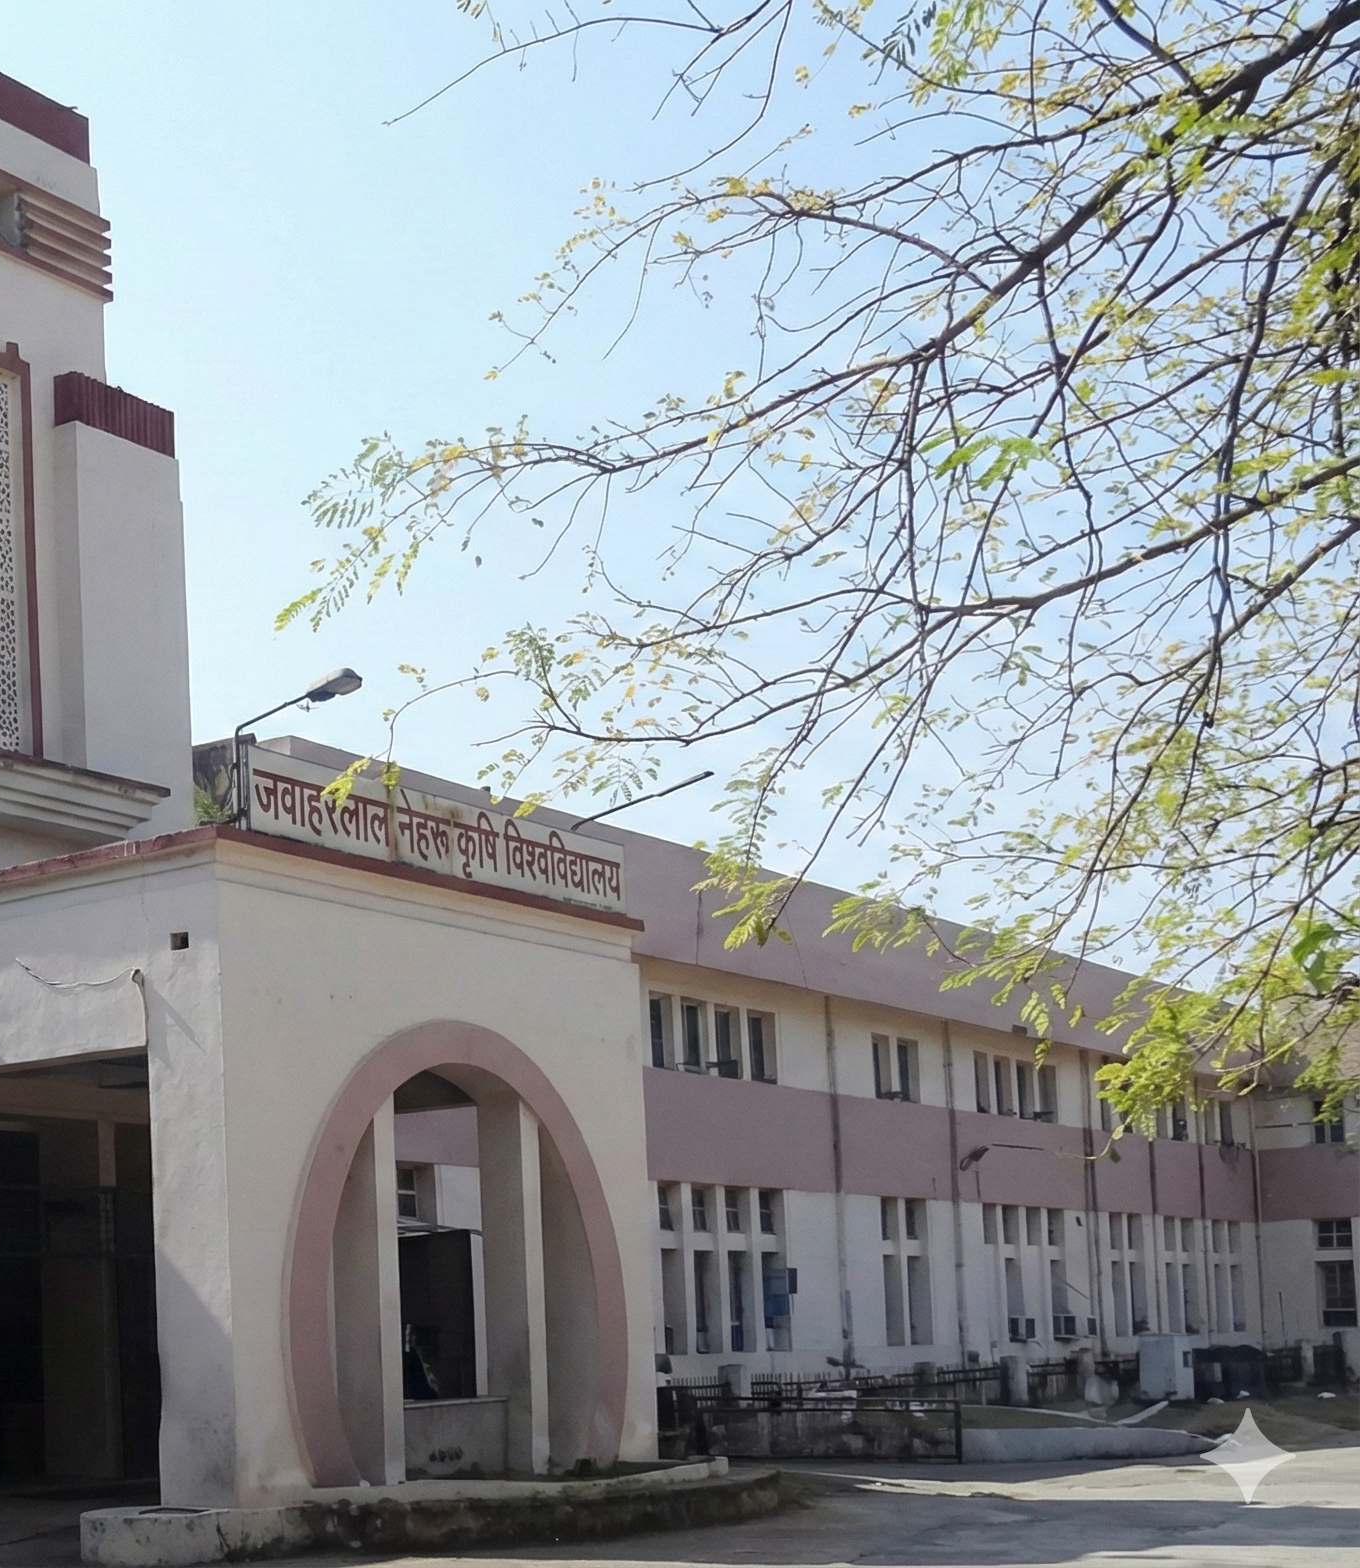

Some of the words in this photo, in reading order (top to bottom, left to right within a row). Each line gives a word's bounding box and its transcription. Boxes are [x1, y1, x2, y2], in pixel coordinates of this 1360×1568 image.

[252, 768, 390, 848] जवाहरलाल
[396, 787, 451, 862] नेहरू
[453, 811, 500, 879] कृषि
[503, 818, 621, 901] विश्वविद्यालय
